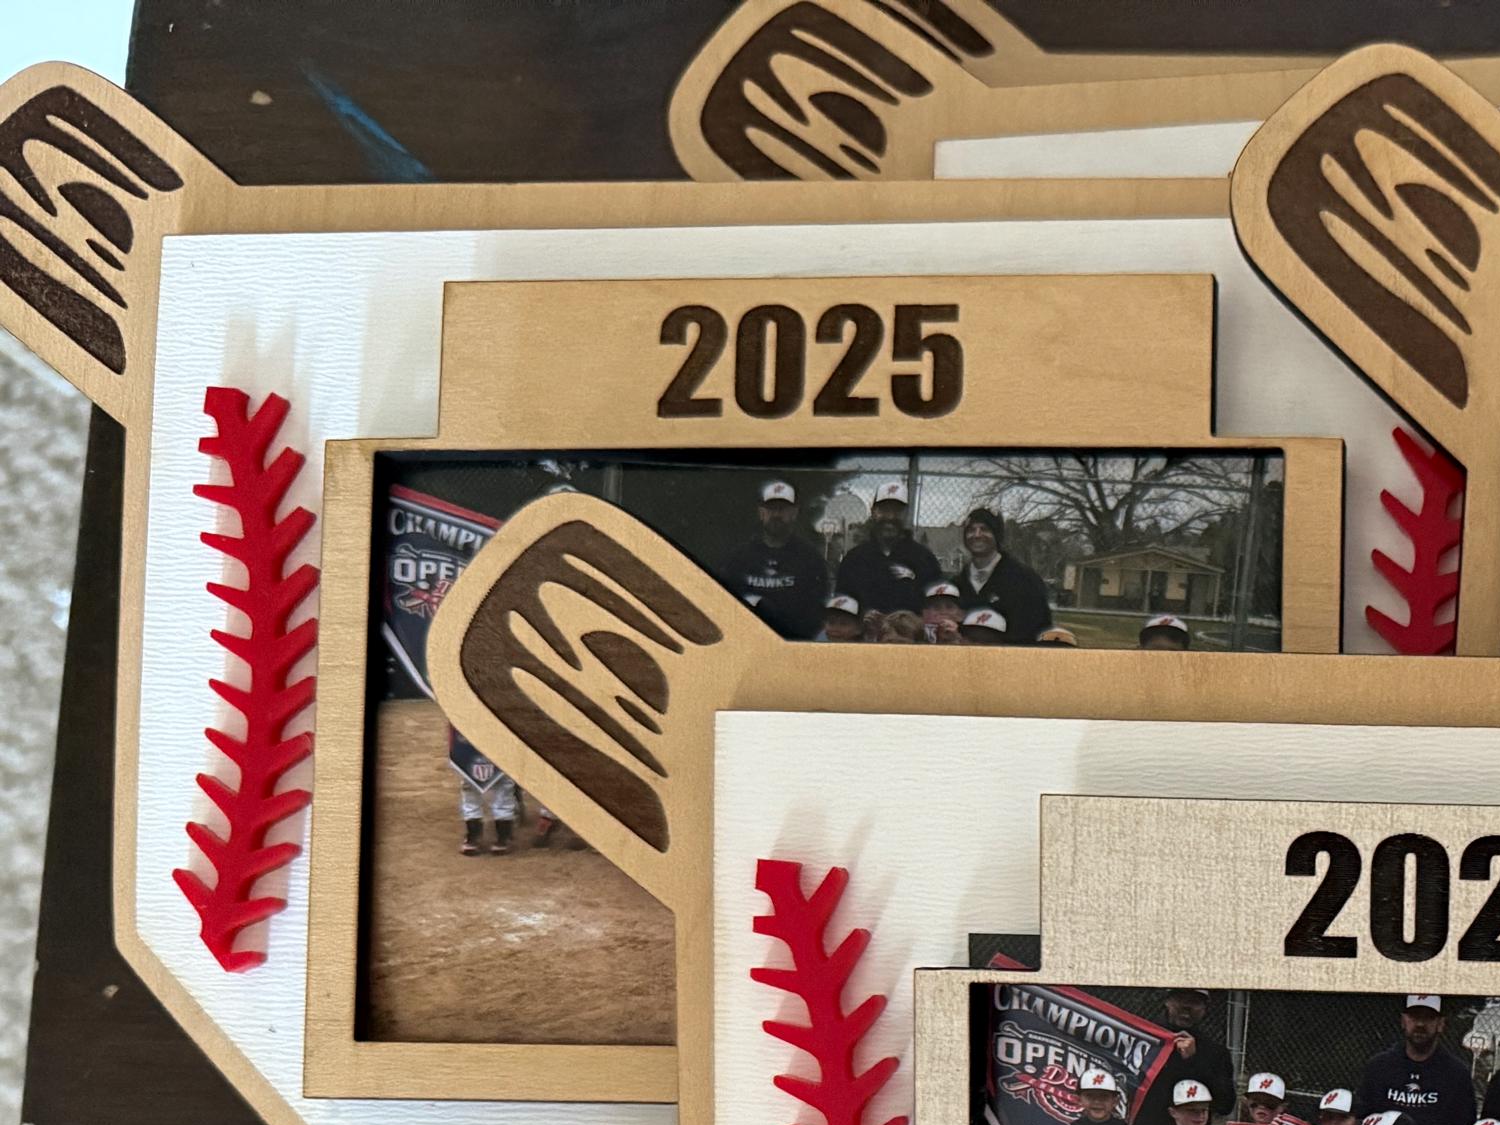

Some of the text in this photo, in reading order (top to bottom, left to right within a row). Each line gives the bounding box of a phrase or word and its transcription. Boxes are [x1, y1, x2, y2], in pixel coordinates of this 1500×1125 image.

[657, 303, 965, 420] 2025
[994, 984, 1152, 1076] CHAMPIONS
[1387, 1088, 1439, 1104] HAWKS
